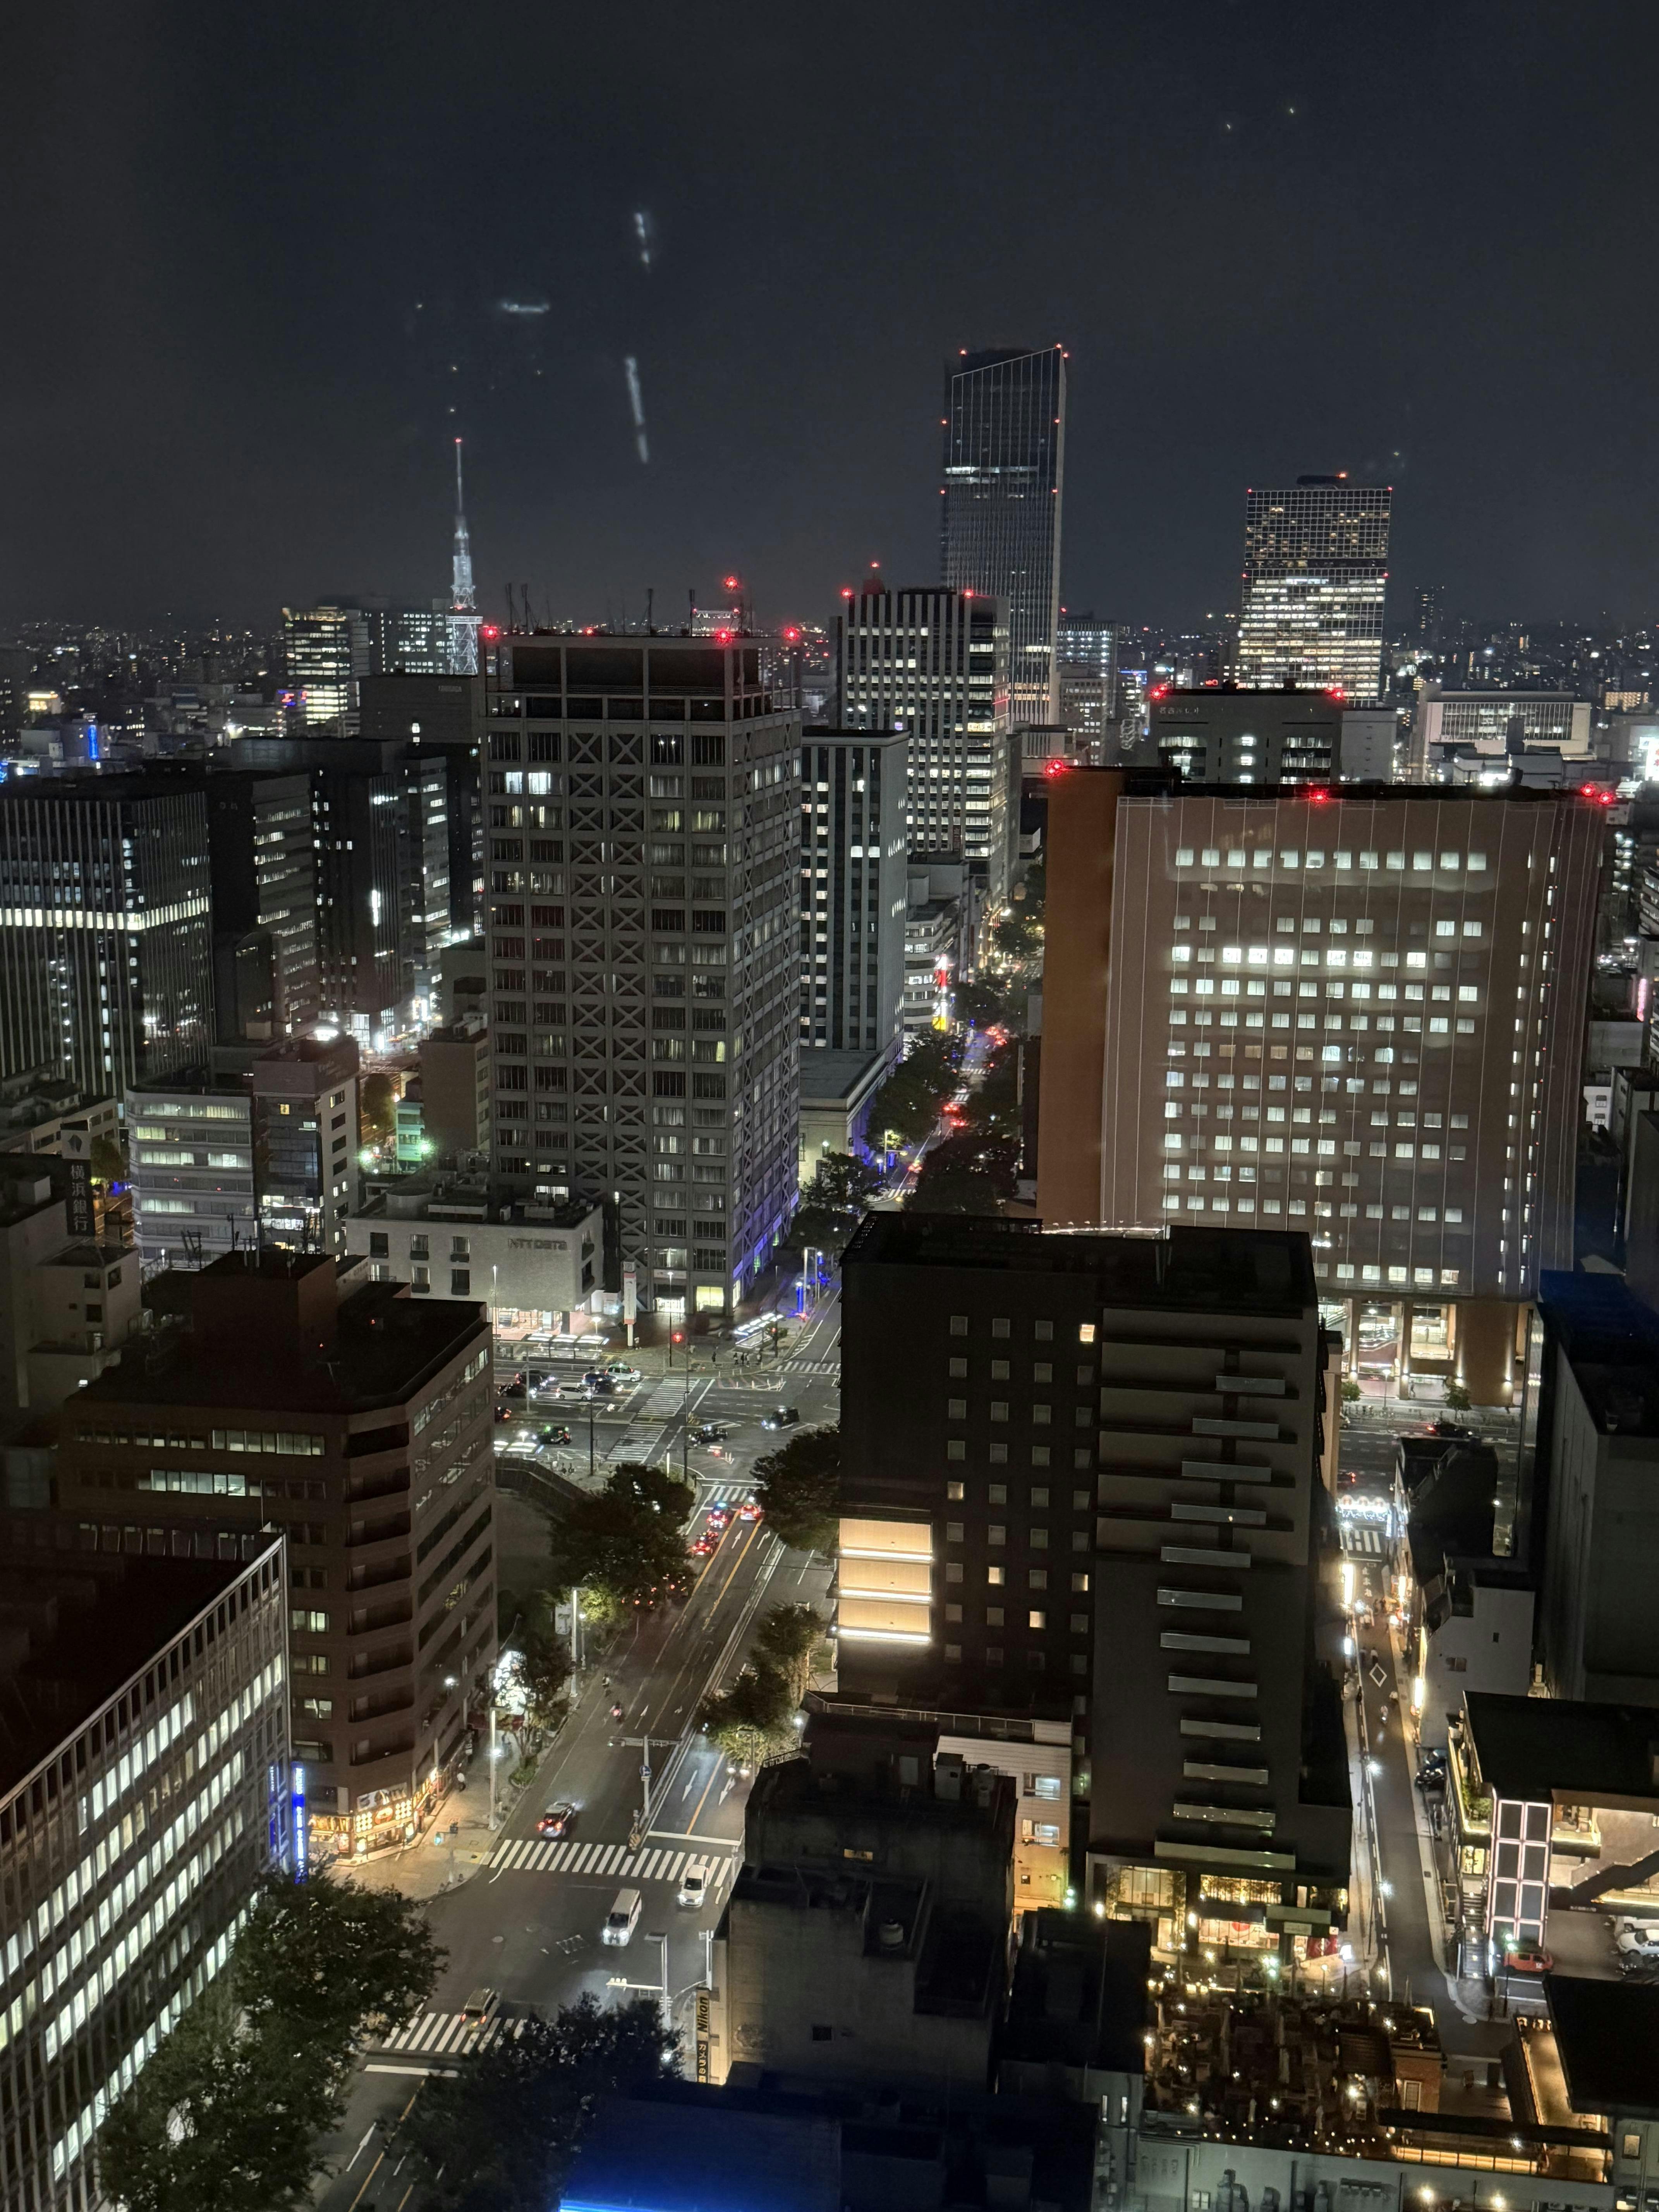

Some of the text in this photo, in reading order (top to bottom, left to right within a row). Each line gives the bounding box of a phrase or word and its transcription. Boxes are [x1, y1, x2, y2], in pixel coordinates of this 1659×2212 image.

[71, 1164, 88, 1231] 横浜銀行
[508, 1238, 532, 1249] NTT
[698, 1996, 708, 2033] Nikon
